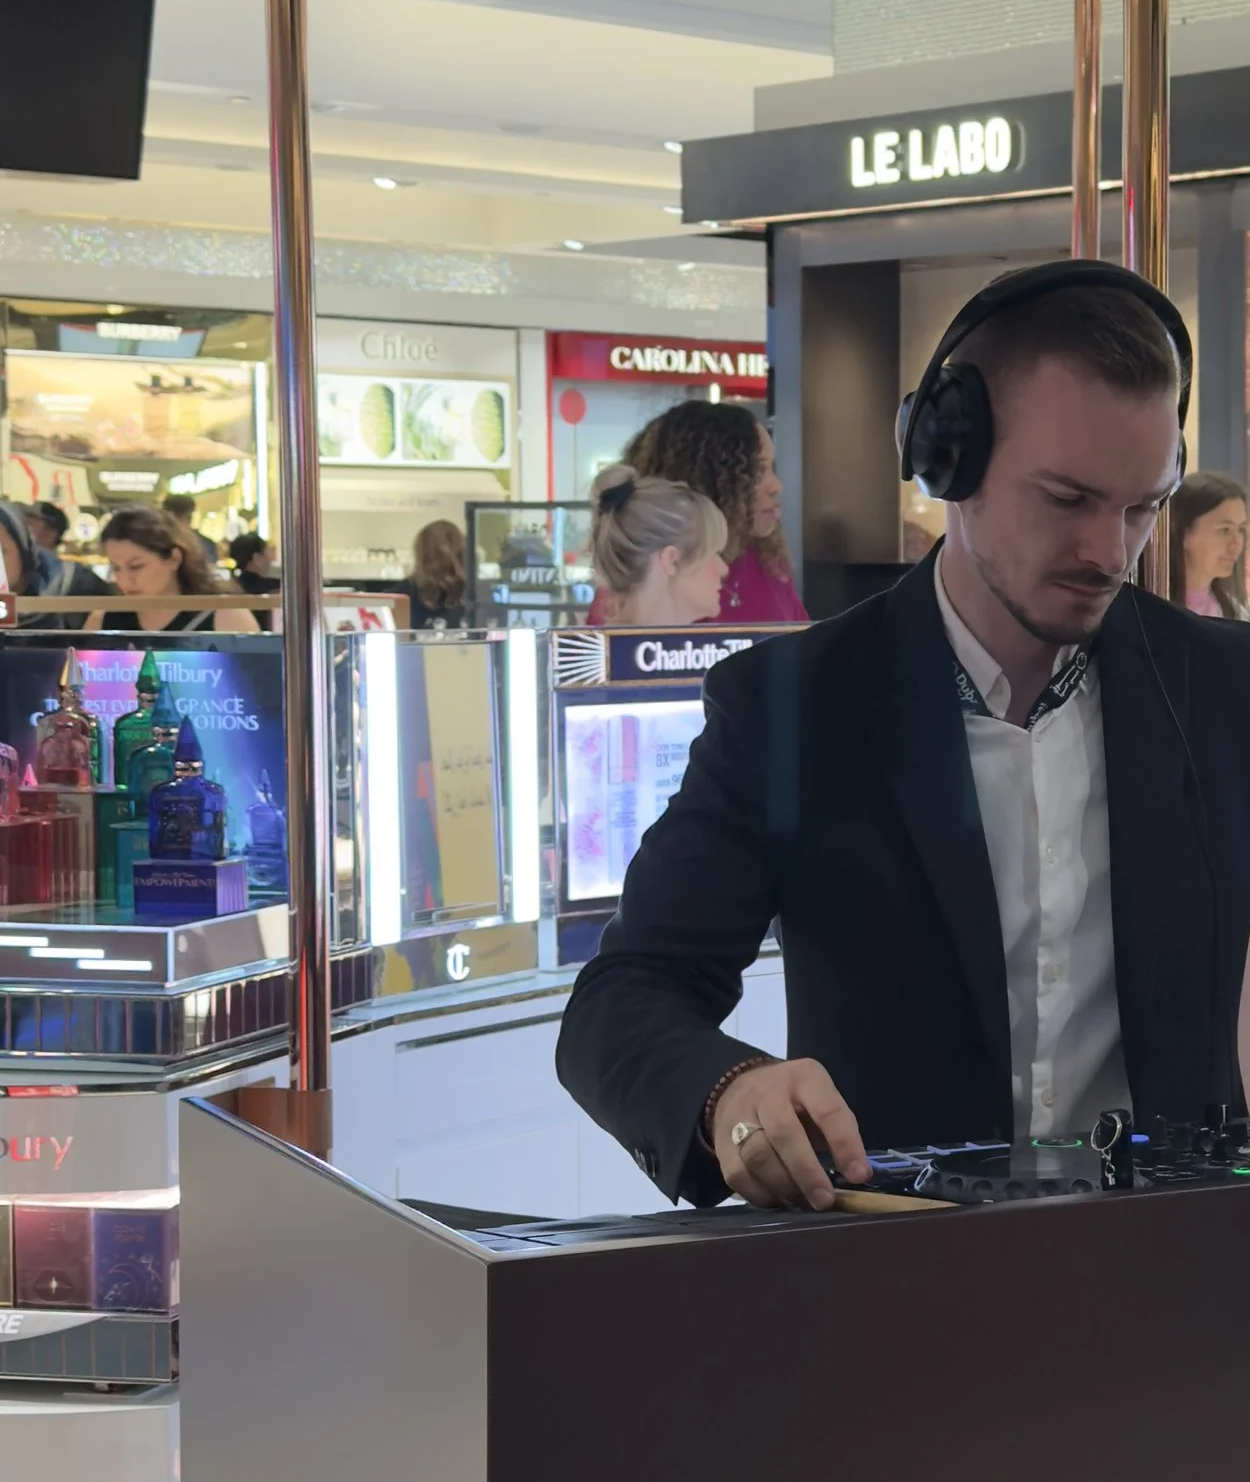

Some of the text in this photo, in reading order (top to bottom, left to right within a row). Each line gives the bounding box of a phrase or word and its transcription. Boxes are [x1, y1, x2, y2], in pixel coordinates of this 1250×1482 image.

[850, 117, 1012, 188] LE LABO
[360, 330, 438, 362] Chloé
[610, 346, 734, 376] CAROLINA
